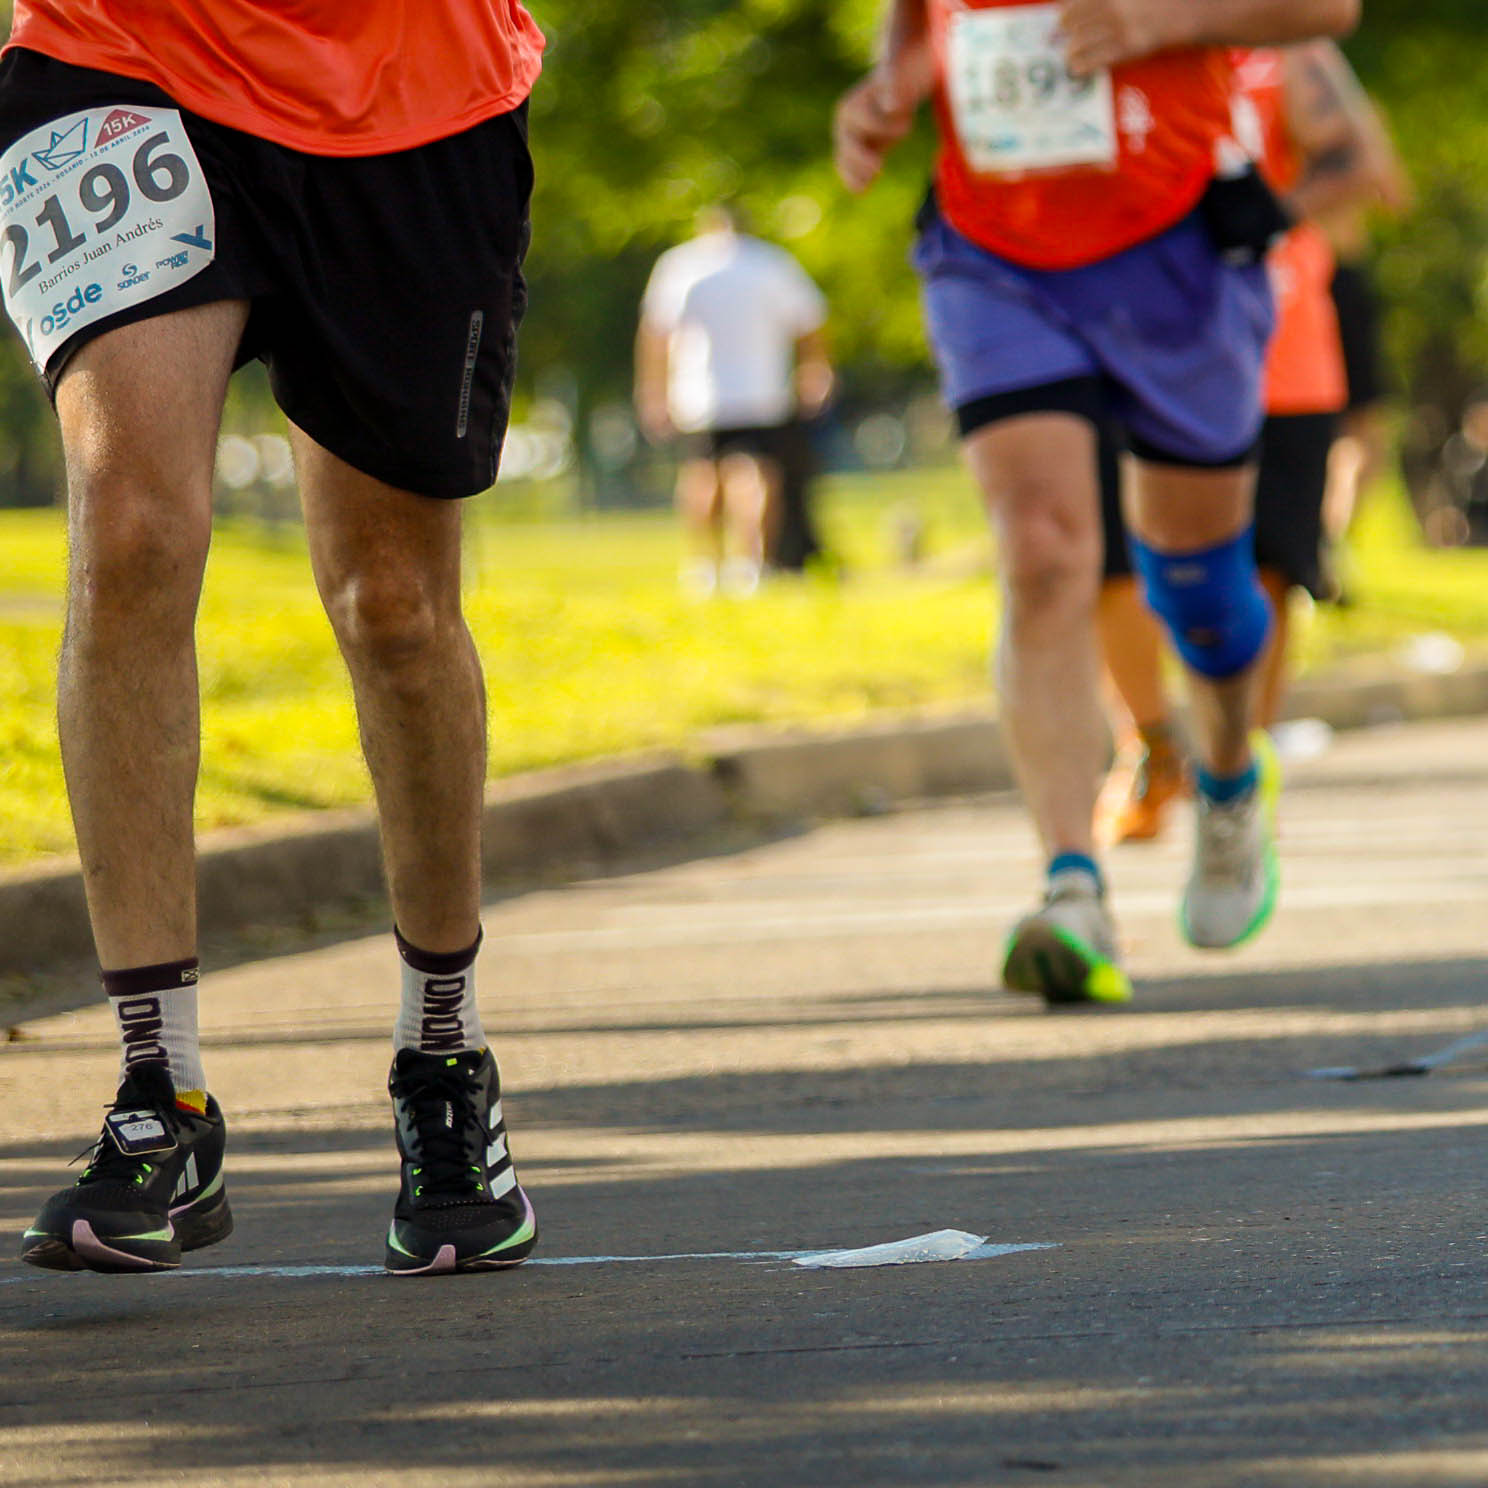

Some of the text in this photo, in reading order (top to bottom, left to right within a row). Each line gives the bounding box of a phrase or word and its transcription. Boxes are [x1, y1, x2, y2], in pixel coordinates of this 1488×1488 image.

[103, 113, 137, 136] 15K
[111, 135, 130, 148] ABRIL
[0, 158, 38, 207] 5K
[1, 130, 190, 299] 2196
[37, 217, 164, 295] Barrios Juan Andrés
[40, 282, 103, 337] osde
